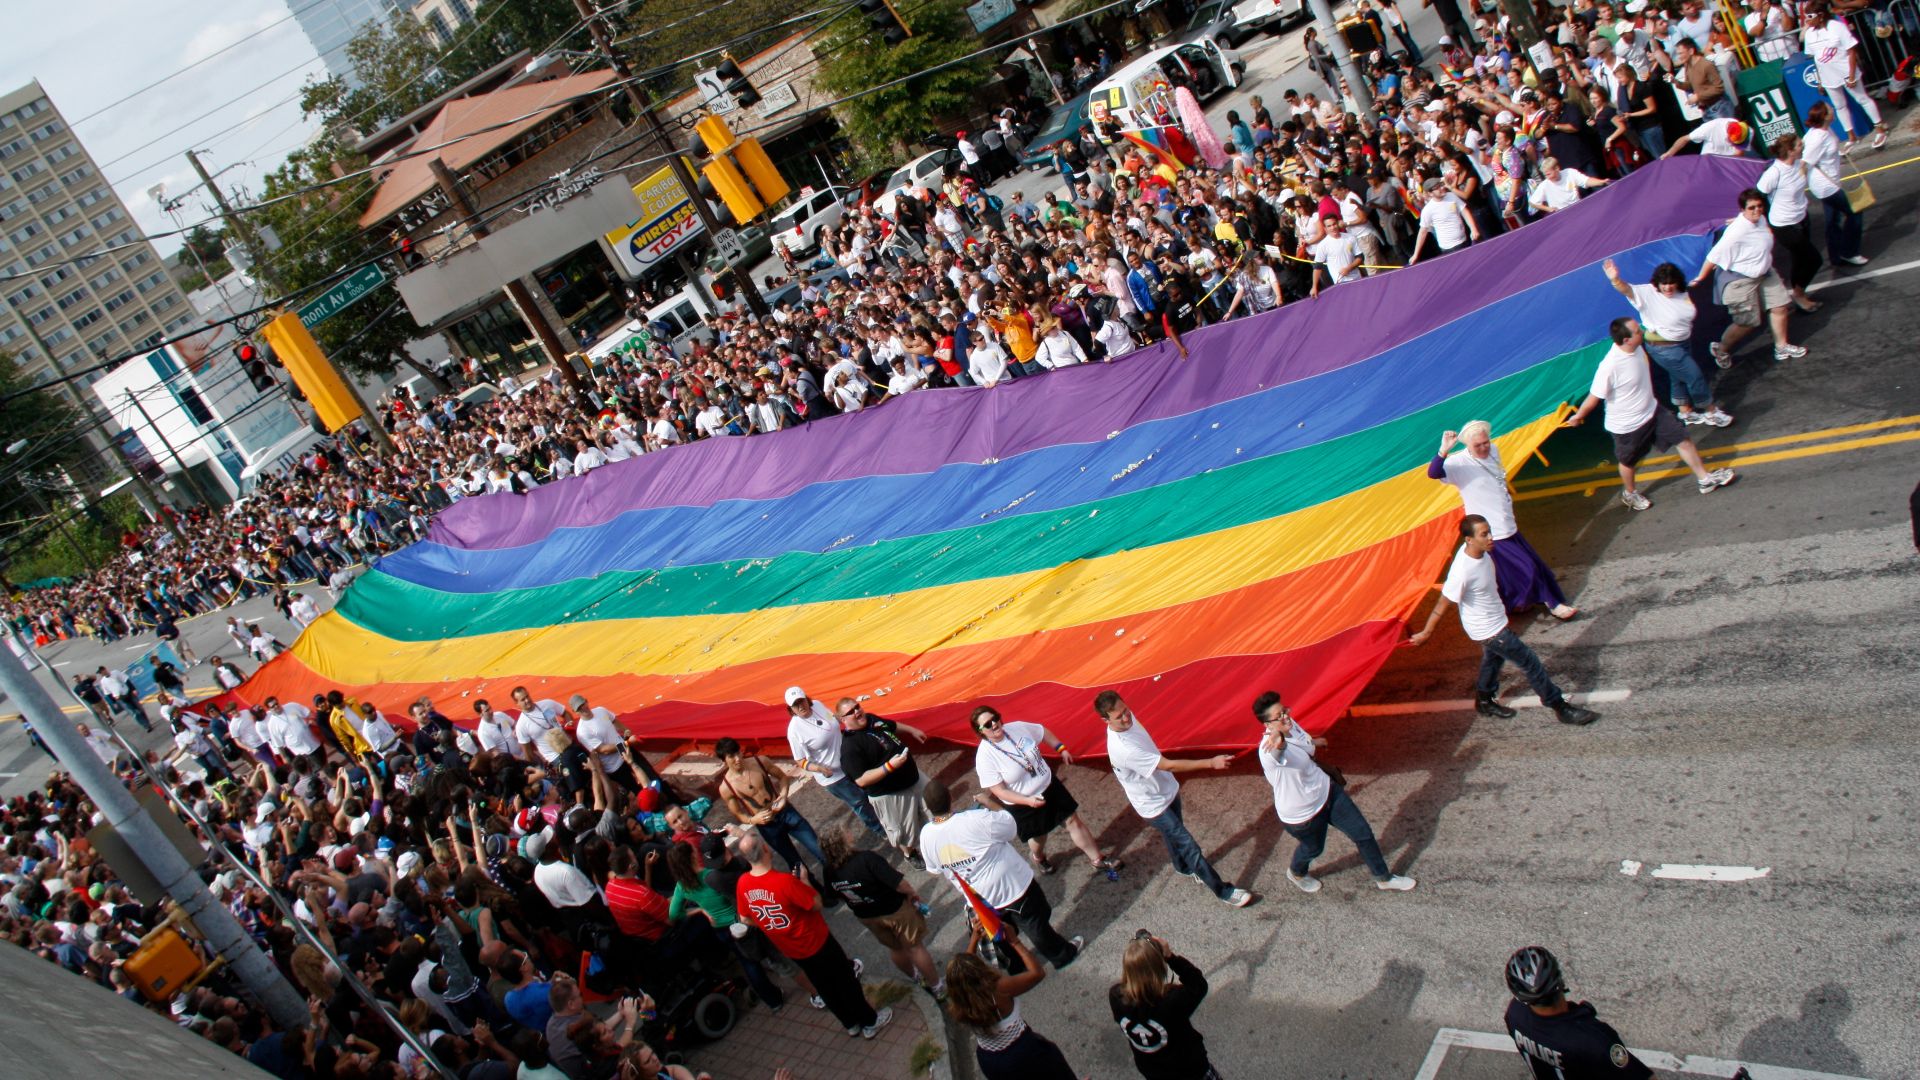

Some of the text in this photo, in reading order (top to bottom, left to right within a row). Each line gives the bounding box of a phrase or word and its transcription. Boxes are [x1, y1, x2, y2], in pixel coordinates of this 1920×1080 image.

[711, 100, 730, 112] ONLY
[1760, 119, 1793, 134] CREATIVE
[528, 166, 605, 217] CLEAERS
[648, 186, 686, 215] COFFEE
[632, 201, 697, 250] WIRELESS
[649, 214, 697, 257] TOYZ
[717, 229, 733, 244] ONE
[720, 238, 737, 253] WAY
[329, 292, 345, 308] Av
[343, 280, 355, 291] NE
[348, 283, 365, 297] 1000
[744, 889, 776, 904] LOWELL
[749, 904, 791, 930] 25
[1514, 1029, 1565, 1070] POLICE
